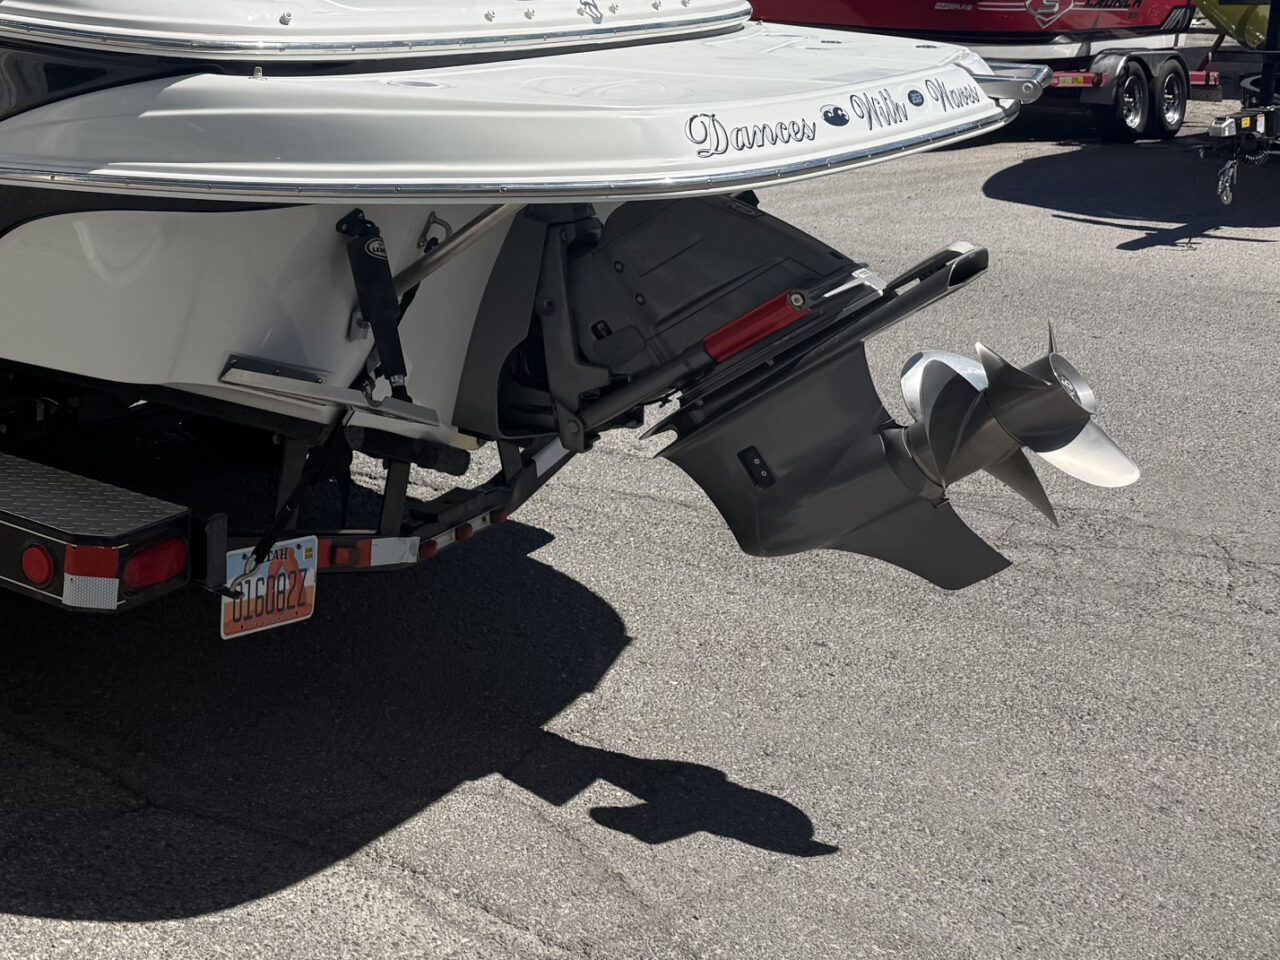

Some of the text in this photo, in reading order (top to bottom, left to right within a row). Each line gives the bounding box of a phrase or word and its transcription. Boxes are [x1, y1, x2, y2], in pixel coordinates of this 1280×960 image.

[684, 113, 817, 158] Dances
[849, 88, 908, 131] With
[266, 547, 288, 560] TAH
